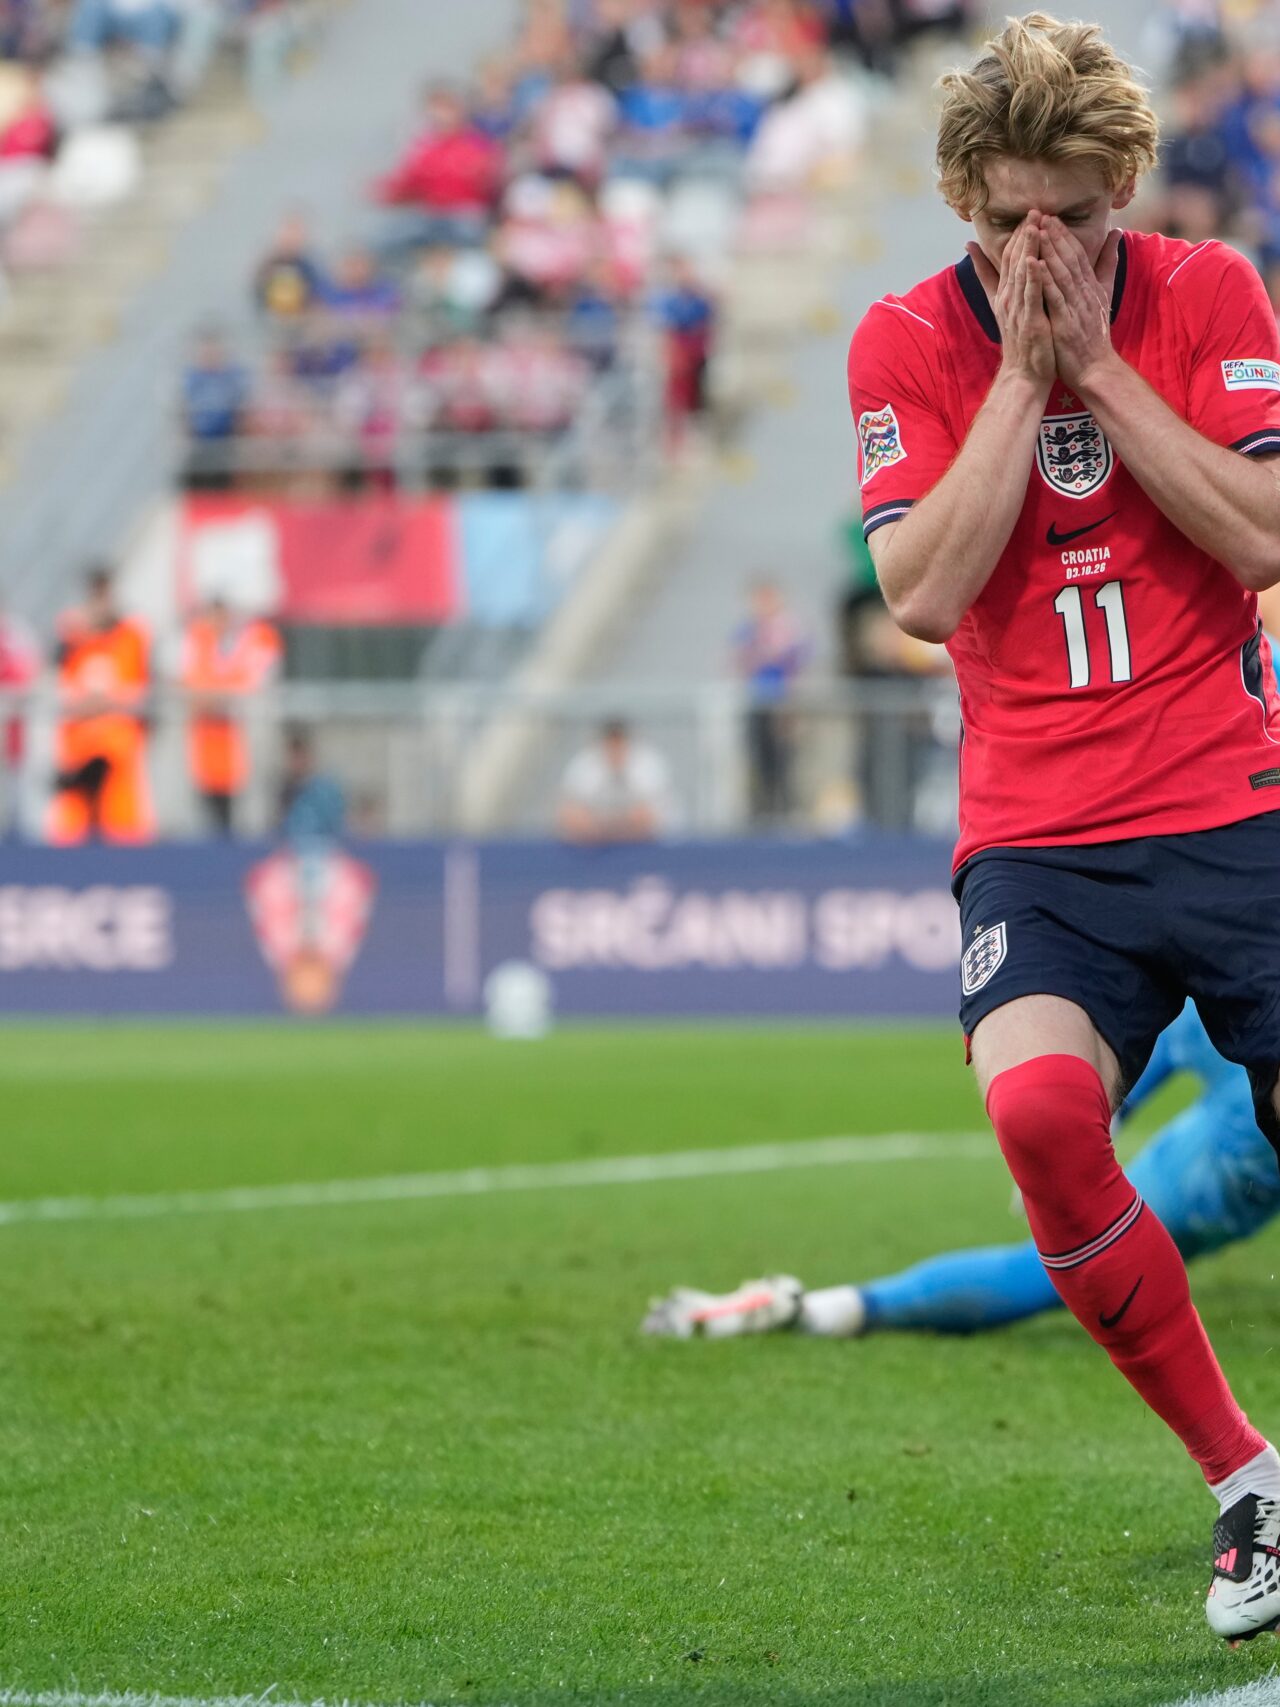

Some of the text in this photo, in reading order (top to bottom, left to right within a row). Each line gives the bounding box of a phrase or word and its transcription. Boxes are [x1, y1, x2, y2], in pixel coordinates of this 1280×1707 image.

[1061, 546, 1111, 565] CROATIA
[1066, 562, 1106, 579] 03.10.26
[1053, 579, 1132, 688] 11
